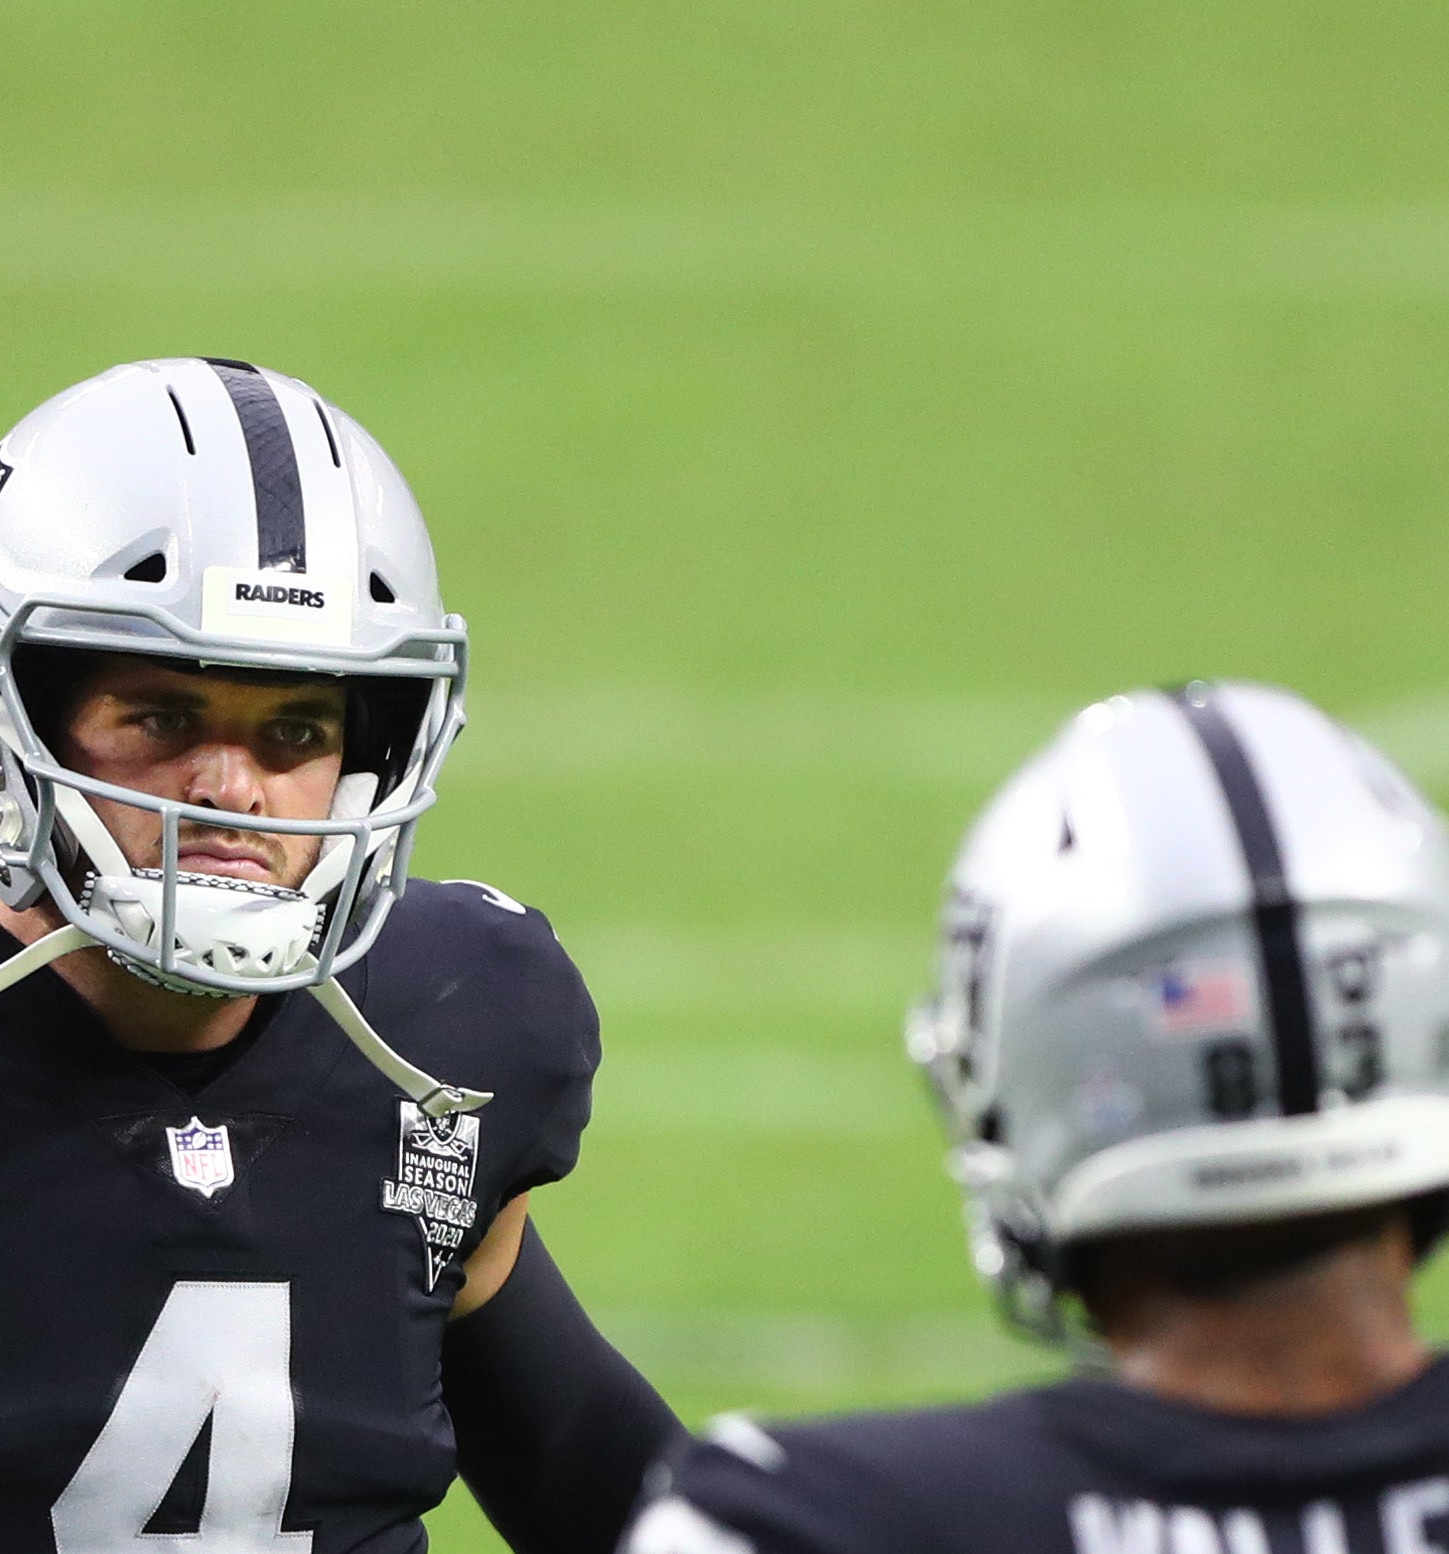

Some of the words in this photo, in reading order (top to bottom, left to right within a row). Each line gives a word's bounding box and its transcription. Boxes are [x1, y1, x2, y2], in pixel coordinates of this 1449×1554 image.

[235, 583, 325, 609] RAIDERS
[183, 1153, 223, 1180] NFL
[405, 1152, 469, 1178] INAUGURAL
[404, 1165, 468, 1196] SEASON
[383, 1180, 424, 1214] LAS
[423, 1188, 478, 1228] VEGAS
[426, 1222, 464, 1249] 2020
